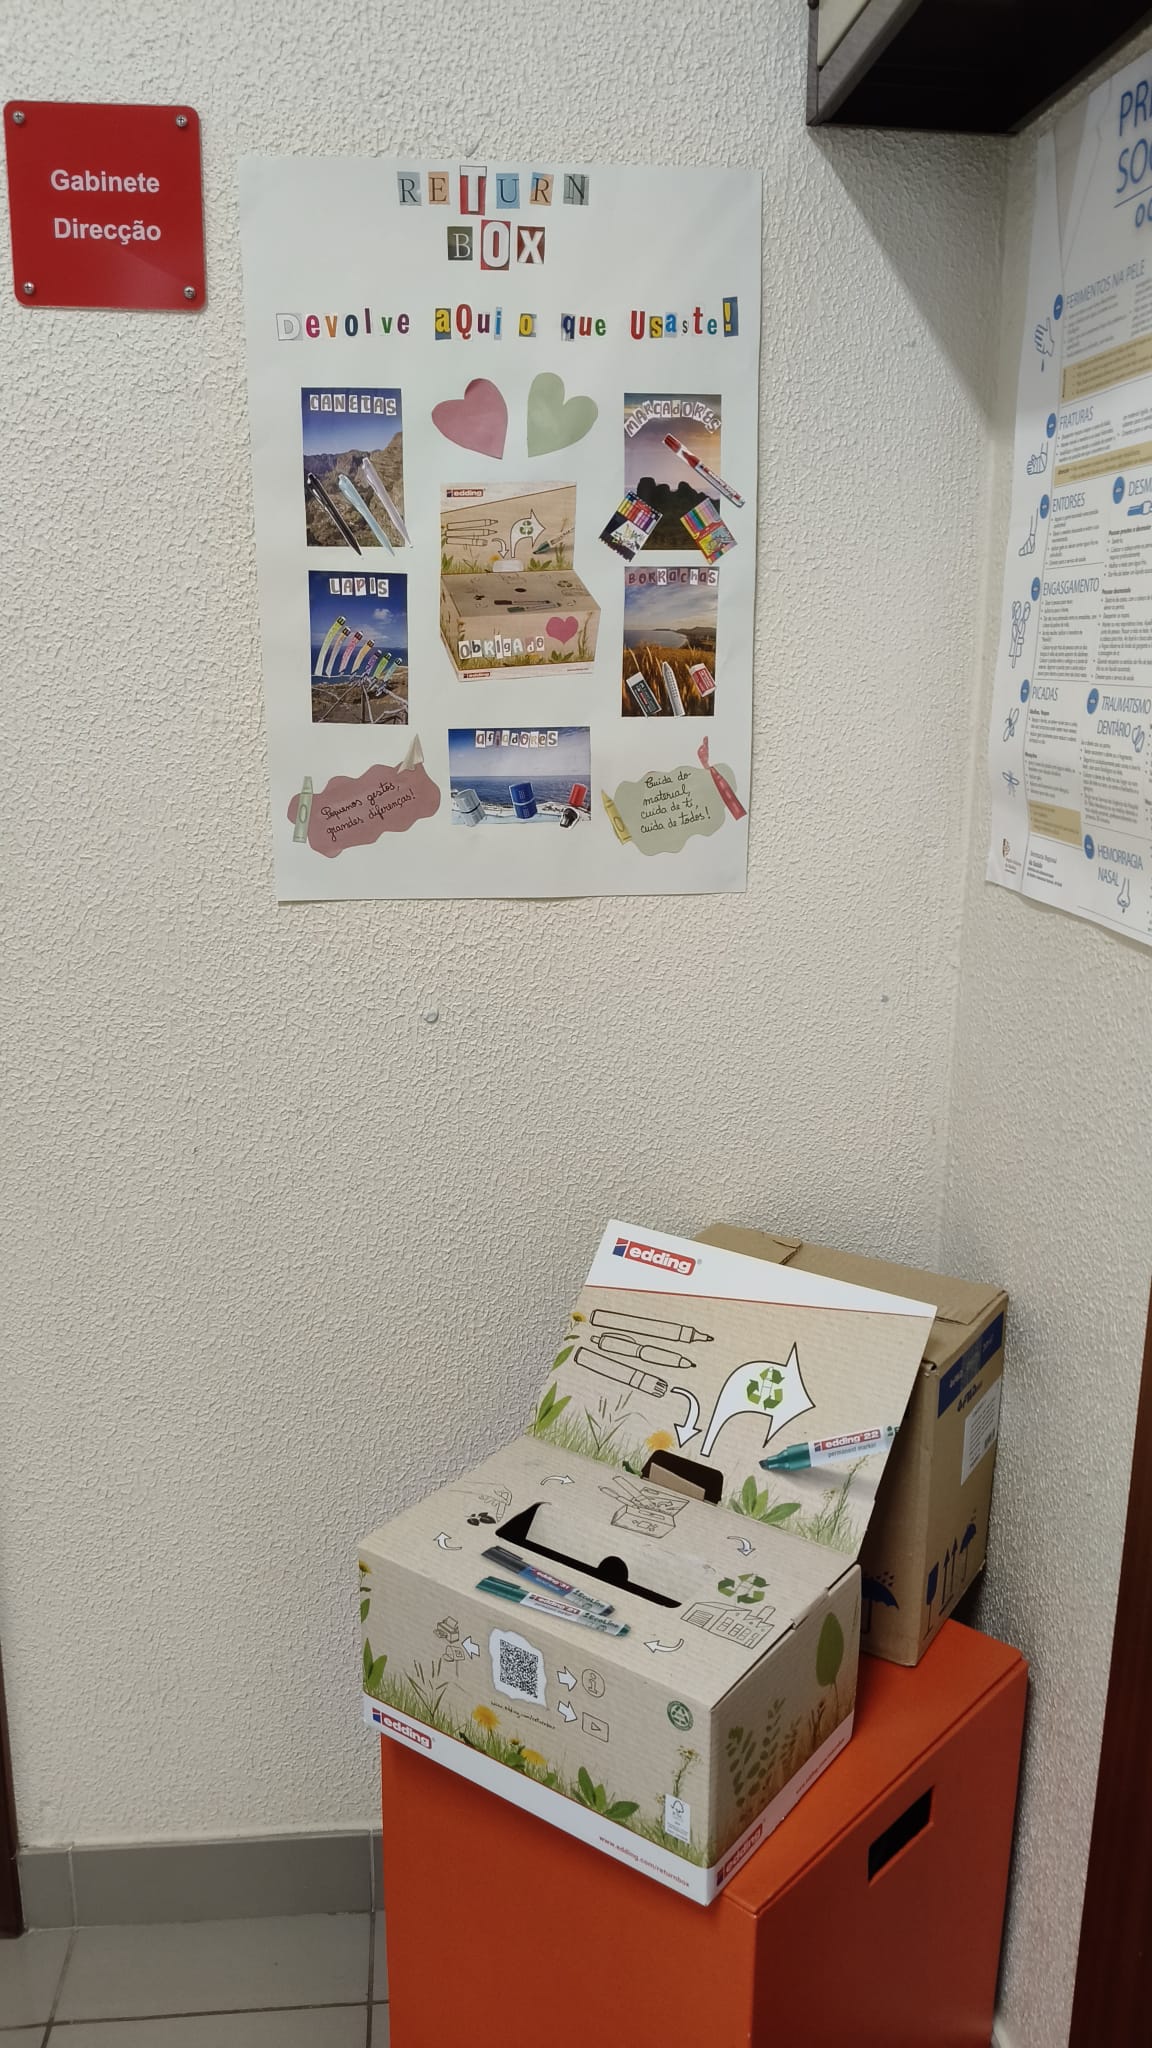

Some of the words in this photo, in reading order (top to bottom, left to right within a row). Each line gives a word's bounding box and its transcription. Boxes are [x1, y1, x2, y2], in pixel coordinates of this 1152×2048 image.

[1119, 80, 1152, 137] PR
[50, 169, 160, 193] Gabinete
[398, 166, 590, 213] RETURN
[54, 218, 161, 245] Direcção
[452, 220, 545, 268] BOX
[276, 307, 410, 341] Devolve
[562, 313, 606, 341] que
[310, 395, 397, 415] CANETAS
[1059, 406, 1095, 431] FRATURAS
[1052, 492, 1086, 513] ENTORSES
[330, 578, 389, 597] LAPIS
[1042, 577, 1100, 597] ENGASGAMENTO
[1031, 686, 1059, 702] PICADAS
[1102, 695, 1151, 715] TRAUMATISMO
[1096, 718, 1132, 738] DENTÁRIO
[644, 776, 673, 789] Cuida
[678, 771, 691, 781] do
[320, 798, 363, 820] Pequenos
[366, 781, 400, 805] gestos,
[643, 784, 691, 807] material,
[326, 816, 365, 842] grandes
[367, 788, 416, 820] diferenças!
[640, 806, 668, 820] cuida
[670, 801, 681, 811] de
[640, 821, 665, 834] cuida
[667, 818, 677, 829] de
[679, 806, 711, 825] todos!
[1098, 844, 1144, 871] HEMORRAGIA
[1097, 866, 1120, 888] NASAL
[629, 1246, 693, 1274] edding
[825, 1434, 861, 1450] edding
[383, 1717, 430, 1748] edding
[725, 1825, 762, 1874] edding
